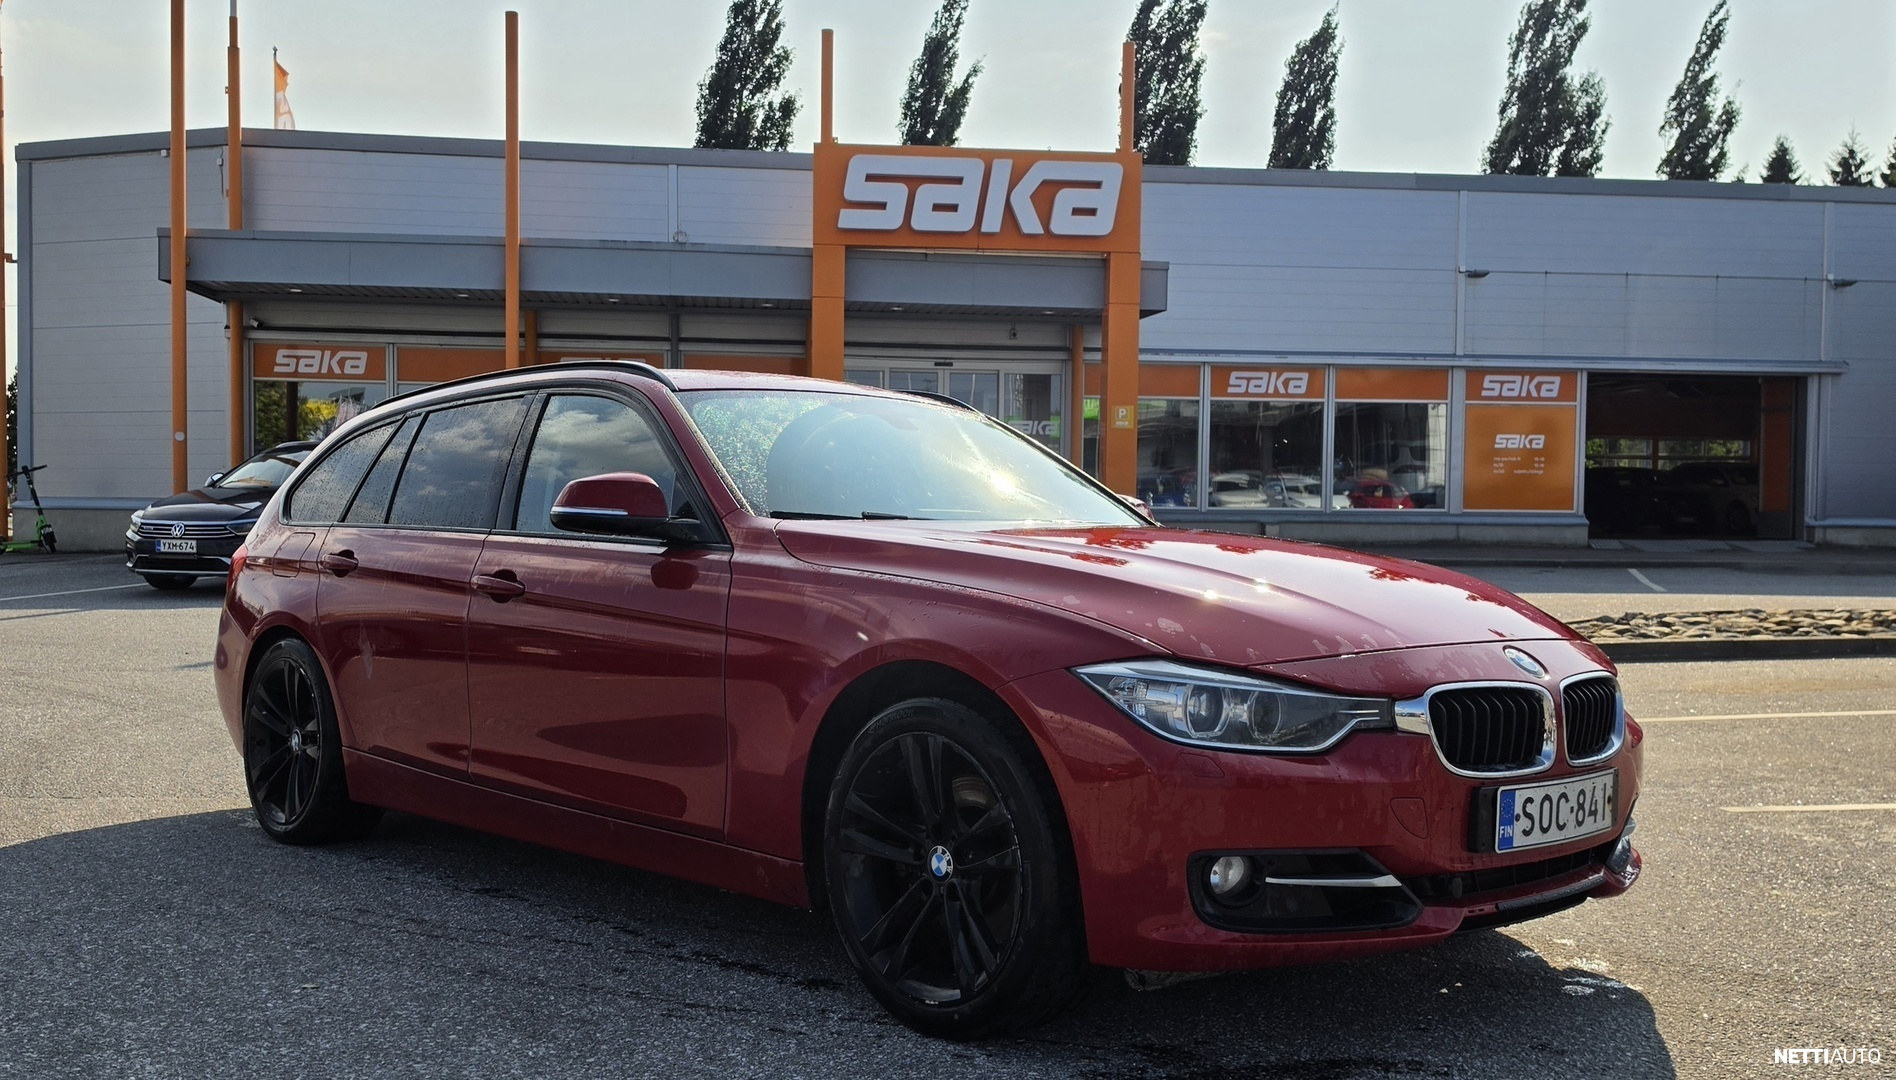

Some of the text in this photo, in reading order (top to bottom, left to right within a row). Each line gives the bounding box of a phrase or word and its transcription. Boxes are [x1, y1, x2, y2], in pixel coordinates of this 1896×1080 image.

[162, 541, 195, 551] YXM-674
[1521, 782, 1607, 837] SOC-841
[1499, 825, 1513, 838] FIN
